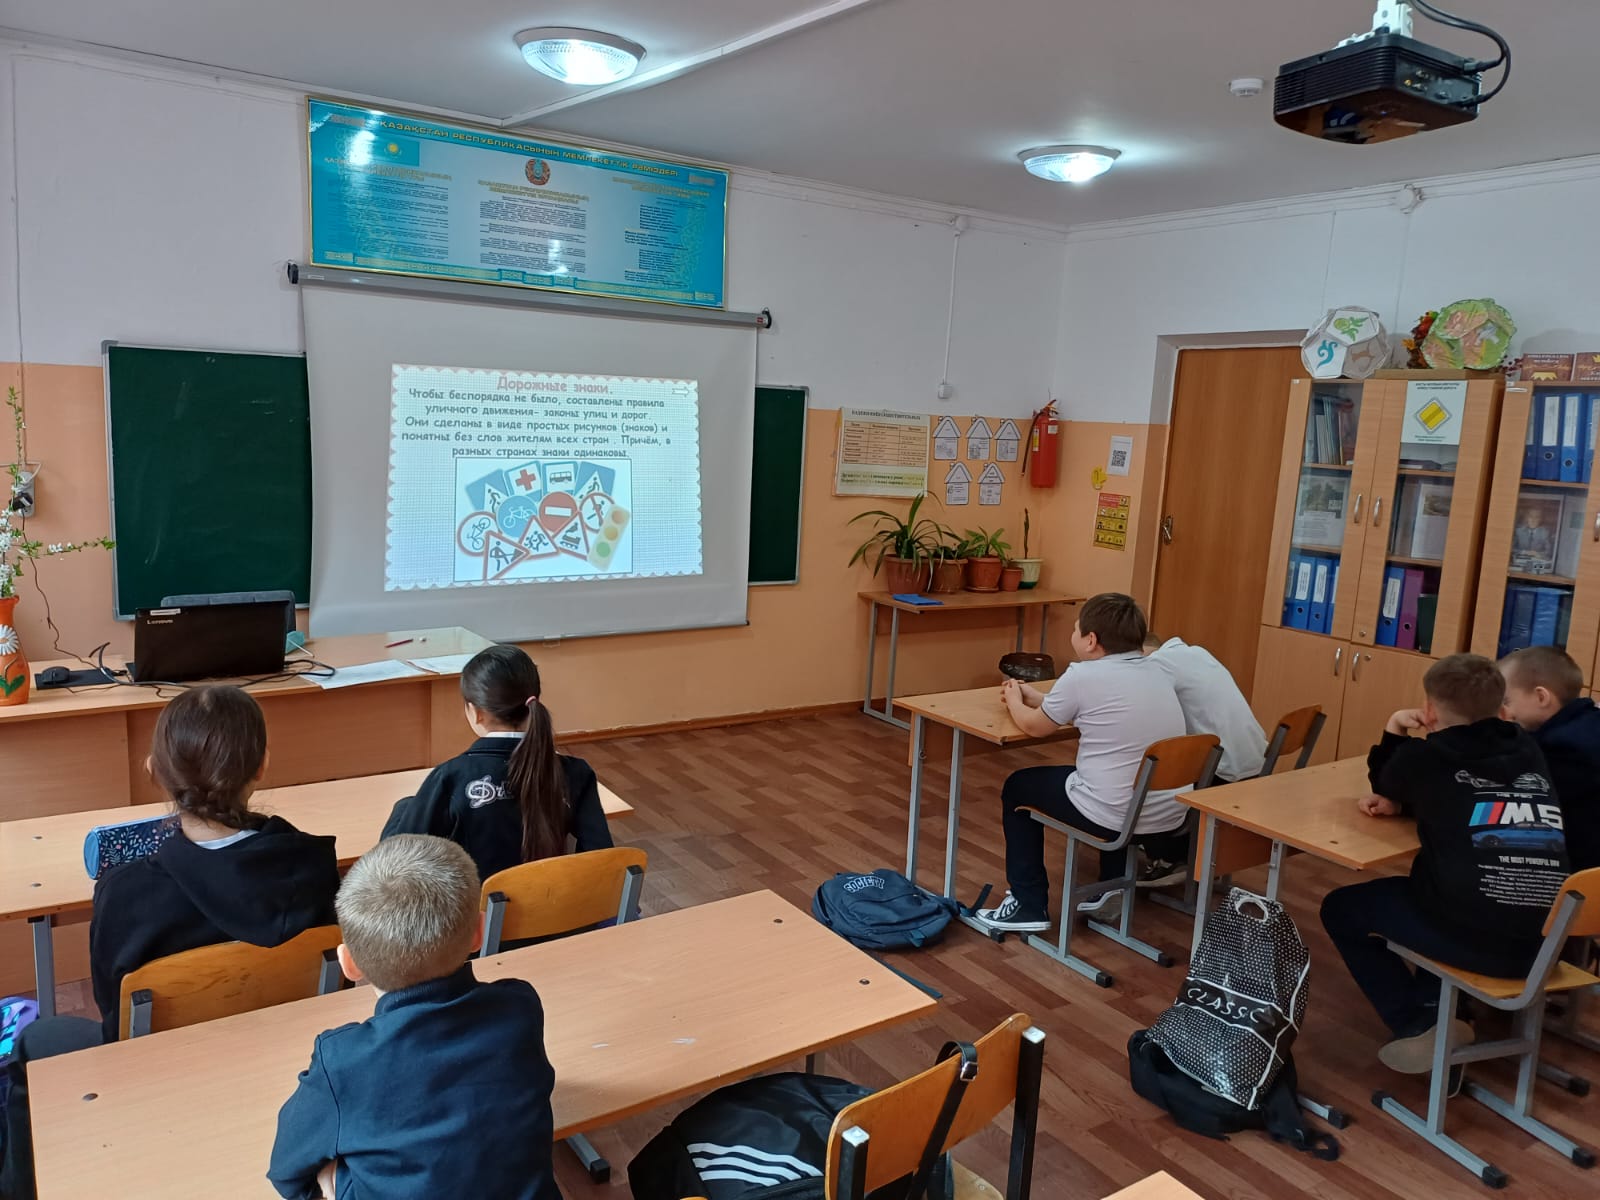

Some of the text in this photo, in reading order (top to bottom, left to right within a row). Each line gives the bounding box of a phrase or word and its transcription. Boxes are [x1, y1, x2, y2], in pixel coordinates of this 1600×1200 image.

[497, 376, 613, 395] Дорожные знаки.
[409, 388, 665, 409] Чтобы беспорядка не было, составлены правила
[425, 404, 478, 416] уличного
[544, 409, 579, 418] законы
[583, 411, 608, 421] улиц
[611, 411, 618, 419] и
[621, 412, 651, 421] дорог.
[405, 416, 429, 427] Они
[433, 417, 482, 429] сделаны
[486, 420, 493, 429] в
[497, 420, 522, 430] виде
[526, 421, 570, 433] простых
[573, 423, 617, 434] рисунков
[621, 422, 658, 433] (знаков)
[401, 431, 450, 443] понятны
[454, 431, 473, 442] без
[477, 433, 503, 444] слов
[506, 434, 552, 444] жителям
[556, 436, 578, 445] всех
[582, 437, 609, 447] стран
[621, 434, 662, 447] Причём,
[451, 446, 492, 459] разных
[495, 448, 538, 459] странах
[542, 448, 570, 457] знаки
[1498, 855, 1510, 864] THE
